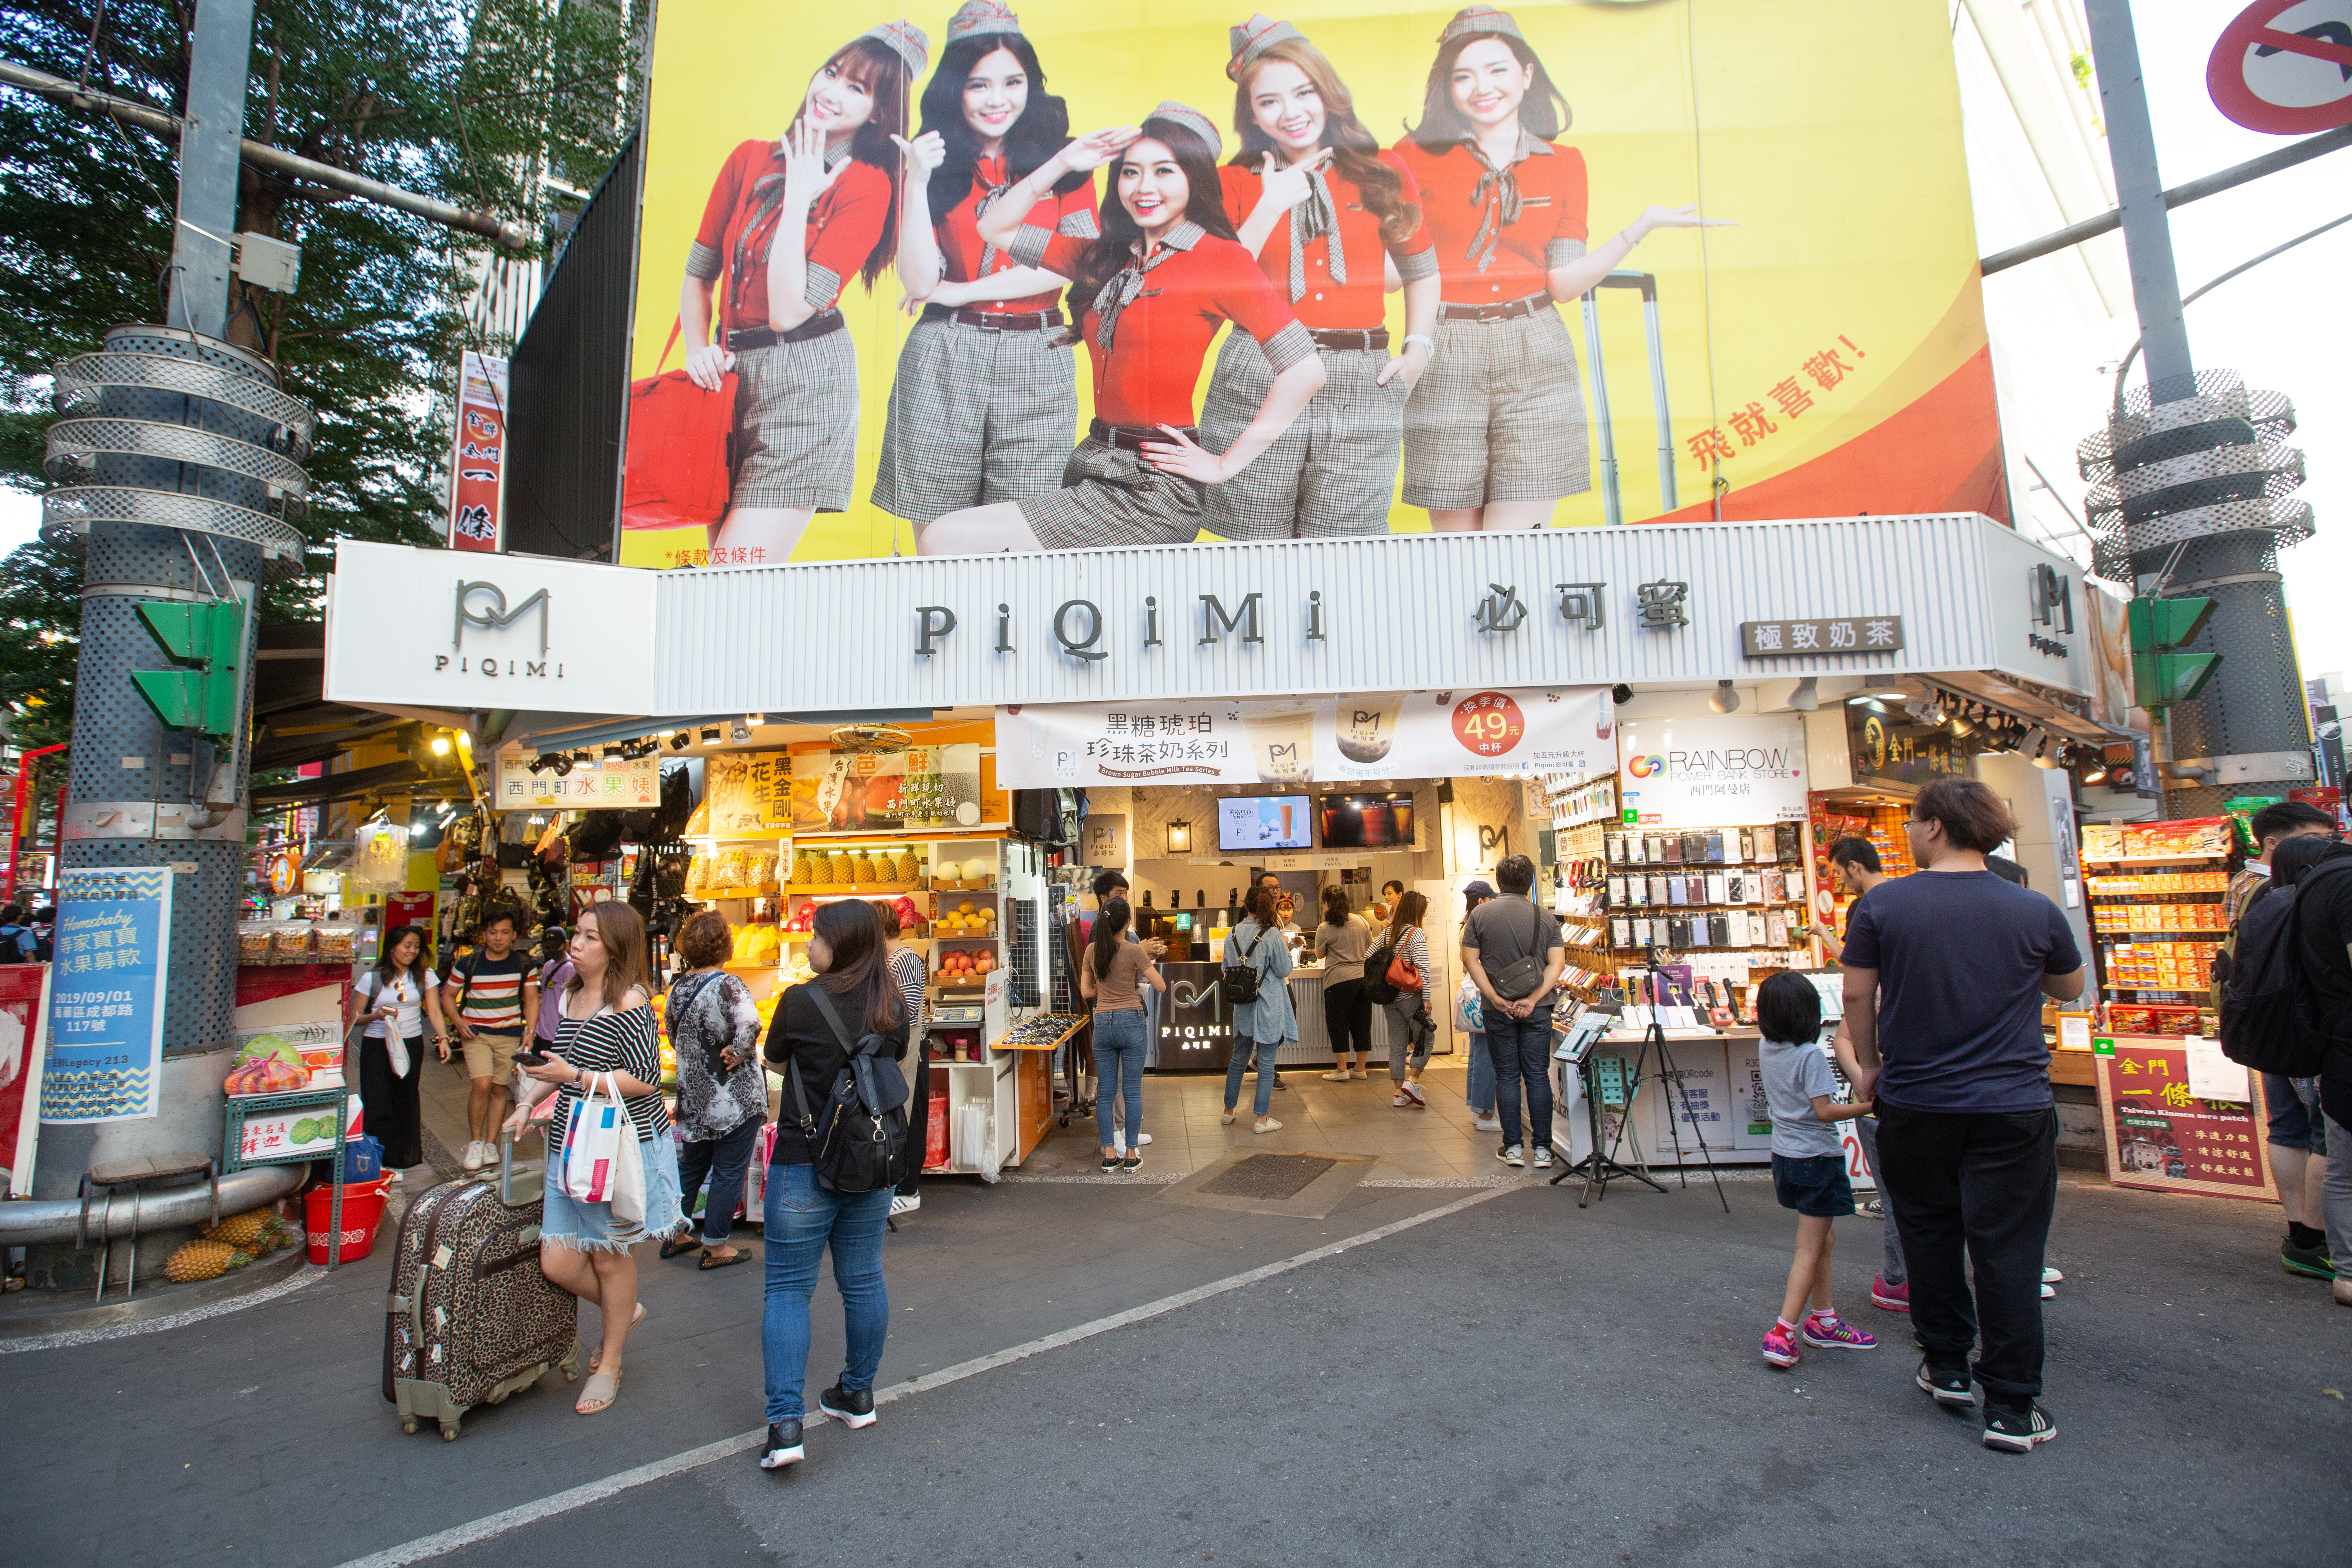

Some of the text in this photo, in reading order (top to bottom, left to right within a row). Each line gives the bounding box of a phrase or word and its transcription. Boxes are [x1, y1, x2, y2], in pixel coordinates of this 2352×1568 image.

[1687, 334, 1865, 472] 飛就喜歡!
[1472, 578, 1689, 633] 必可蜜
[1755, 620, 1893, 650] 極致奶茶
[1106, 712, 1212, 737] 黑糖琥珀
[1087, 738, 1227, 763] 珍珠茶奶系列
[1479, 742, 1501, 753] 中杯
[1533, 751, 1584, 759] 加五元升級大杯
[1670, 748, 1788, 771] RAINBOW
[1101, 767, 1121, 777] Brown
[1670, 769, 1789, 781] POWER BANK STORE
[508, 776, 651, 795] 西門町水果姨
[751, 762, 772, 805] 花生
[773, 757, 792, 817] 黑金剛
[824, 760, 844, 813] 台灣水果
[898, 782, 944, 795] 新鮮現切
[1689, 783, 1750, 796] 西門阿曼店
[887, 796, 956, 810] 西門町水果姨
[63, 909, 134, 931] Homebaby
[60, 927, 138, 954] 等家寶寶
[60, 948, 141, 976] 水果募款
[55, 991, 133, 1004] 2019/09/01
[54, 1004, 134, 1018] 萬華區成都路
[66, 1019, 106, 1032] 117號
[105, 1056, 128, 1065] 213
[2118, 1058, 2169, 1076] 金門
[2121, 1107, 2155, 1115] Taiwan
[2157, 1109, 2195, 1118] Kinmen
[2198, 1147, 2252, 1160] 清涼舒適
[2200, 1163, 2254, 1176] 舒展放鬆
